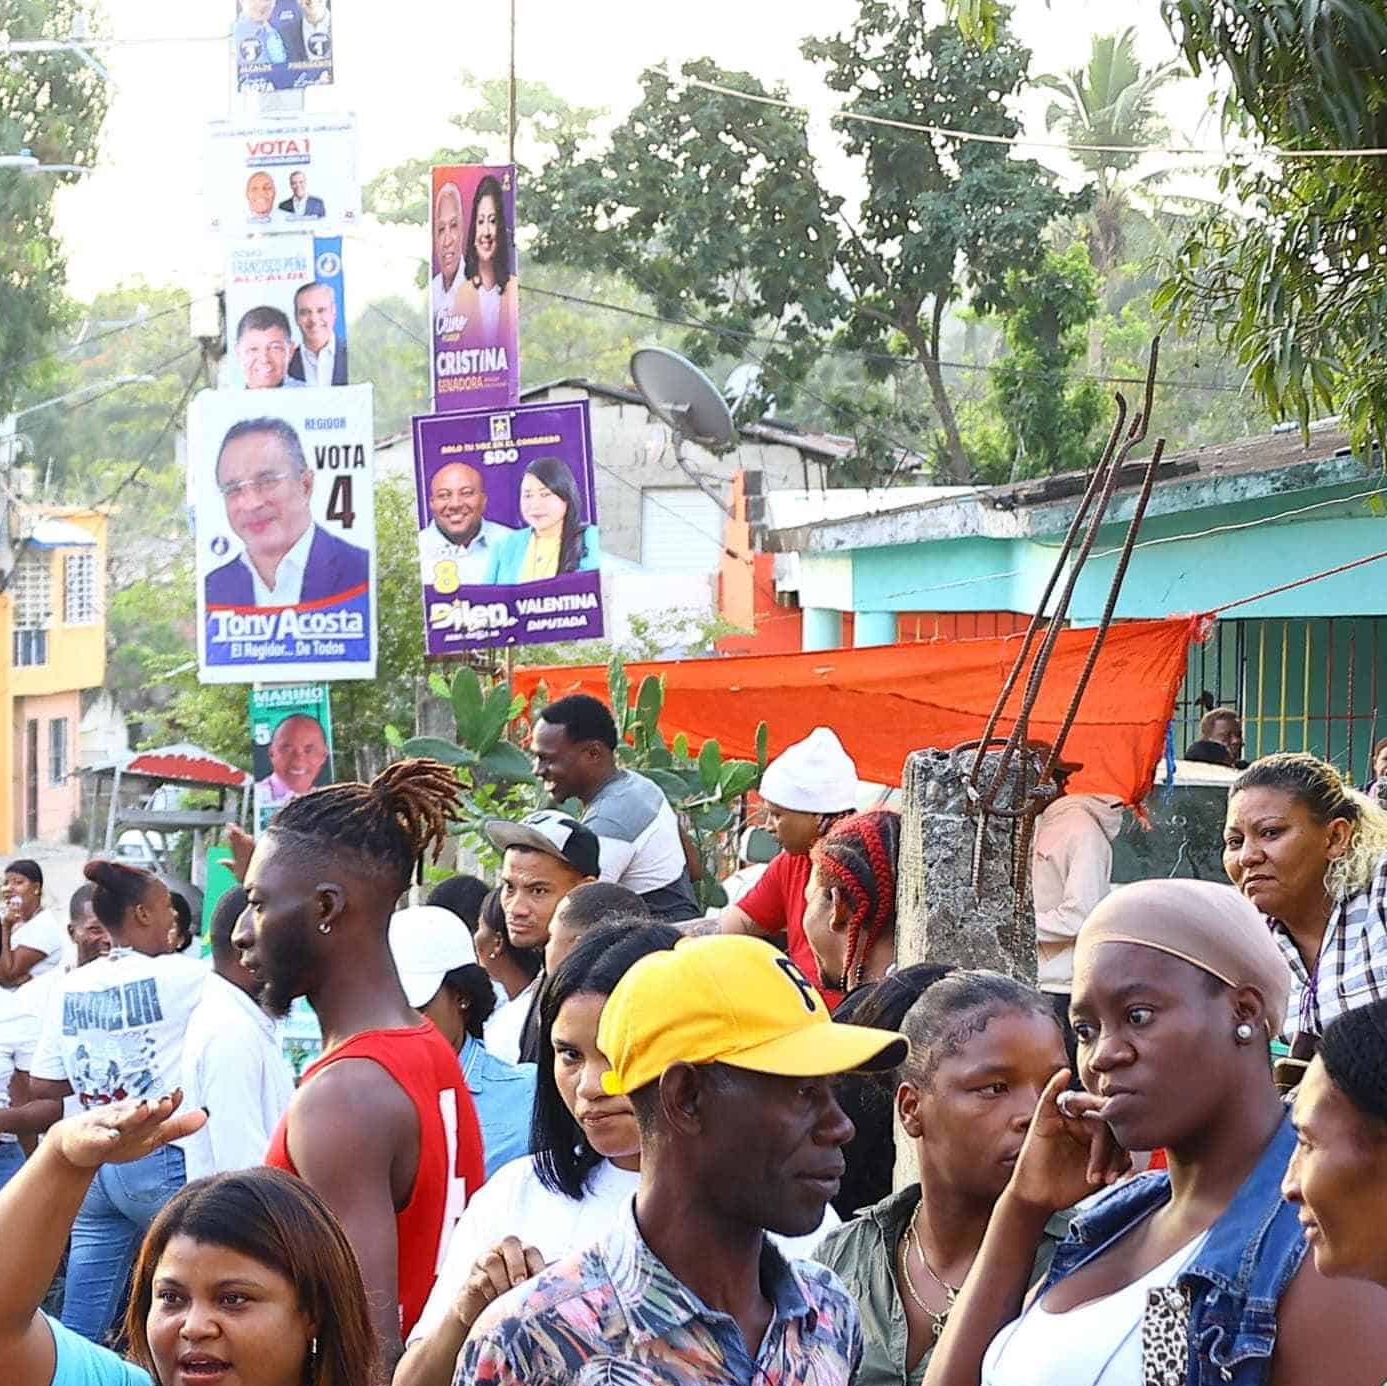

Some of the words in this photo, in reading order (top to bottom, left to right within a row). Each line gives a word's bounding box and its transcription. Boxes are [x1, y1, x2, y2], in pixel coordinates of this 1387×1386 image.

[246, 139, 300, 156] VOTA
[436, 347, 508, 377] CRISTINA
[314, 444, 366, 470] VOTA
[483, 448, 519, 465] SDO
[326, 475, 356, 529] 4
[434, 559, 459, 594] 8
[515, 592, 599, 616] VALENTINA
[211, 609, 277, 643] Tony
[277, 606, 364, 641] Acosta
[527, 614, 588, 632] DIPUTADA
[231, 642, 242, 658] El
[295, 641, 310, 657] De
[312, 641, 346, 656] Todos
[254, 722, 272, 746] 5
